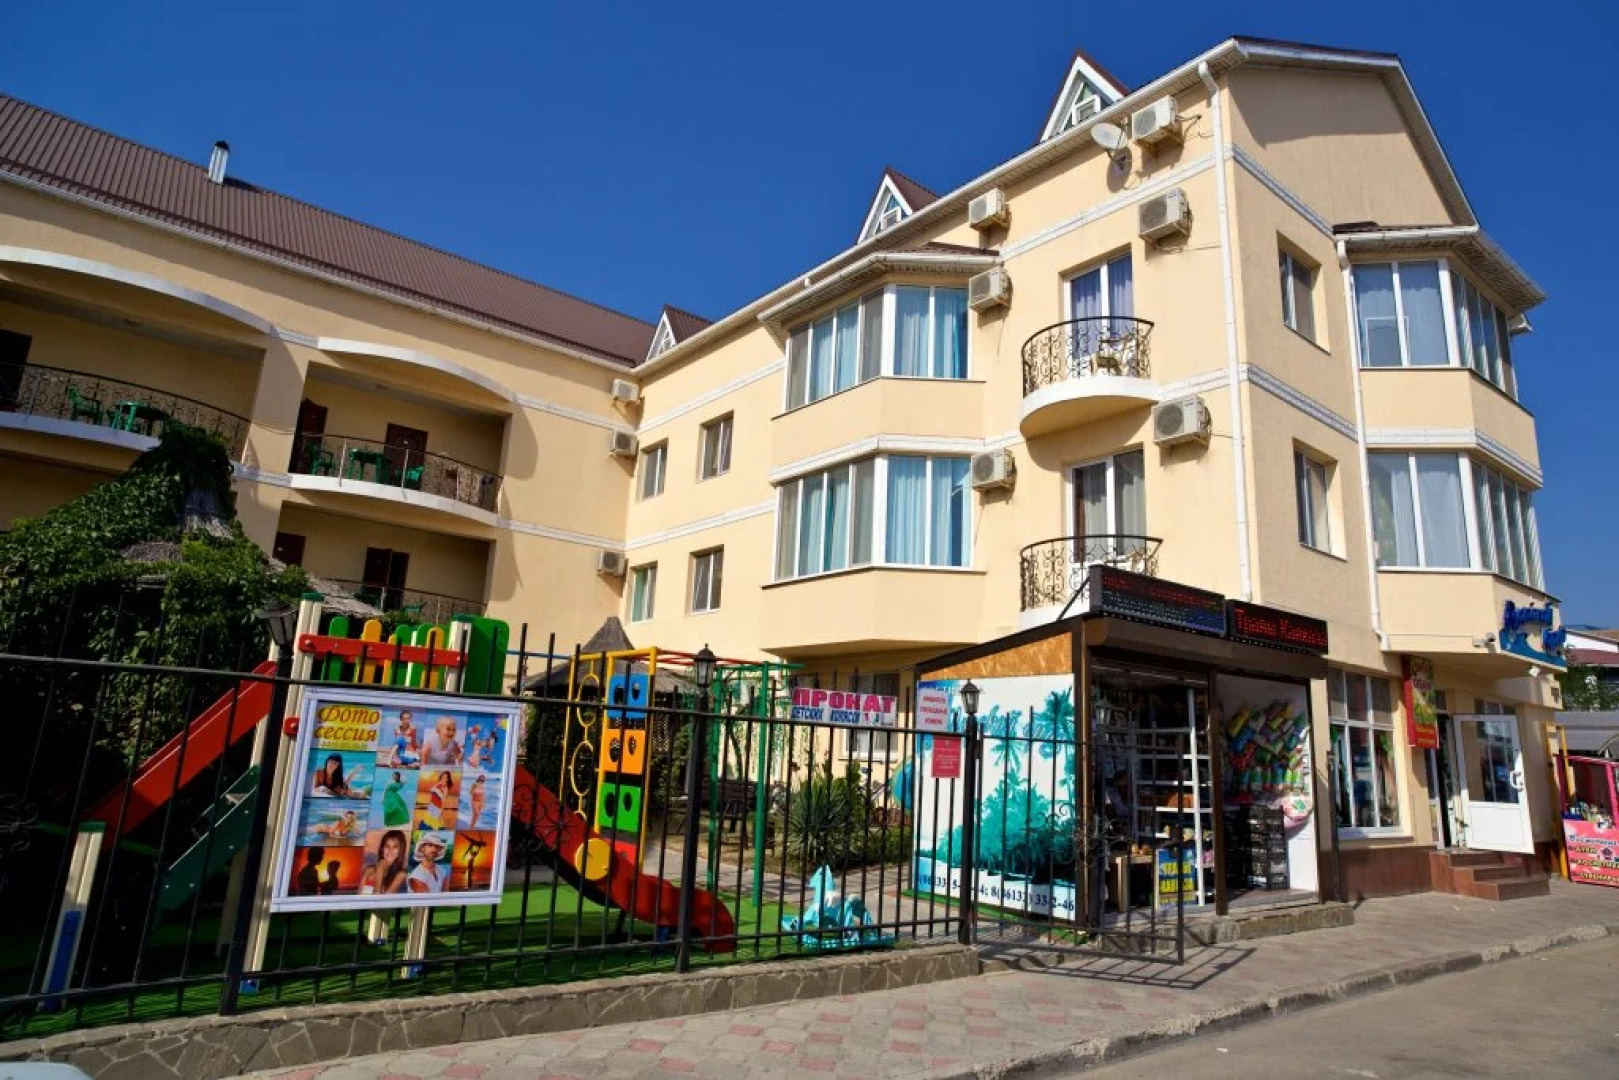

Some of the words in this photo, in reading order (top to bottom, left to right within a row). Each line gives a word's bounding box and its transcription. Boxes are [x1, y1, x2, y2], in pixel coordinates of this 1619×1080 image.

[793, 688, 896, 713] ПРОКАТ
[318, 705, 380, 724] Фото
[315, 726, 377, 742] сессия
